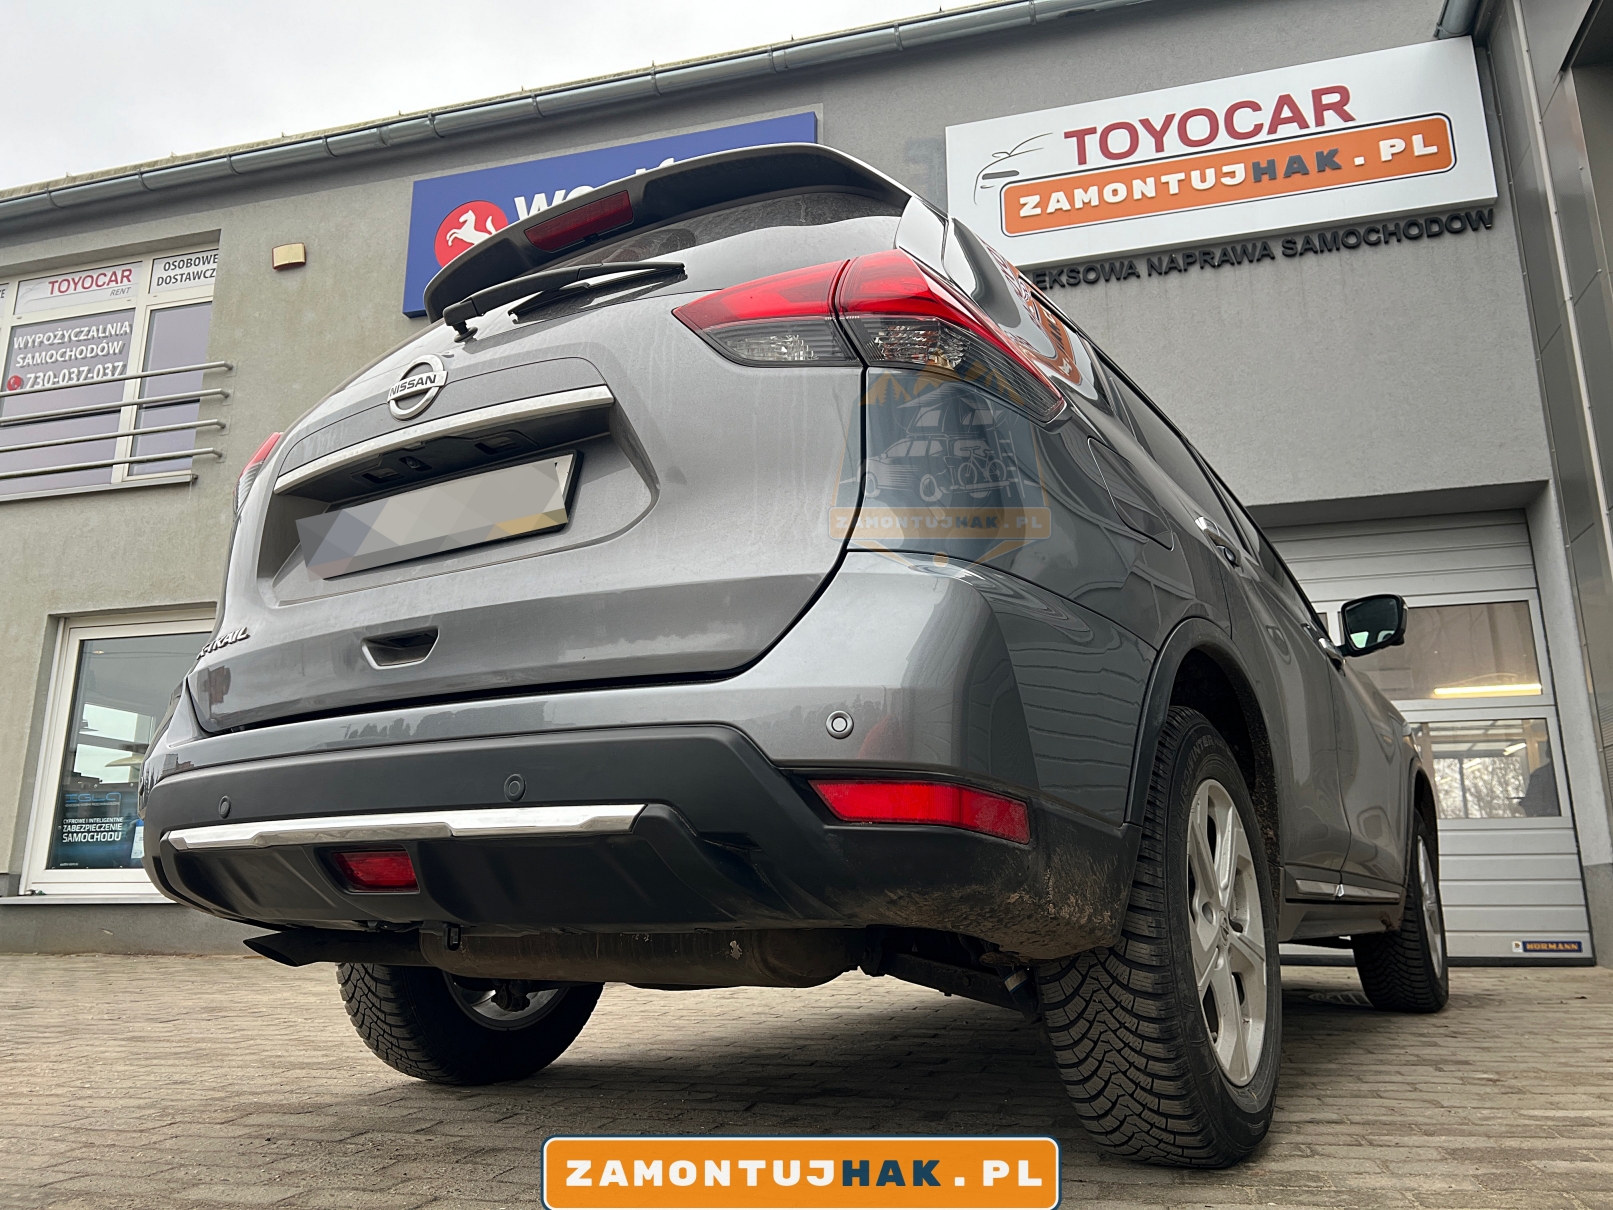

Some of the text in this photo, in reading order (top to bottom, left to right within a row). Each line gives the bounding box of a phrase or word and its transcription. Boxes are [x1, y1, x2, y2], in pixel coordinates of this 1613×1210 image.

[1064, 85, 1356, 165] TOYOCAR
[163, 253, 218, 271] OSOBOWE
[1147, 240, 1276, 278] NAPRAWA
[48, 268, 133, 295] TOYOCAR
[156, 267, 216, 286] DOSTAWCZ
[109, 287, 131, 297] RENT
[13, 321, 130, 349] WYPOŻYCZALNIA
[15, 340, 123, 367] SAMOCHODÓW
[25, 361, 124, 389] 730-037-037
[389, 374, 437, 397] NISSAN
[62, 832, 122, 843] SAMOCHODU
[63, 823, 122, 832] ZABEZPIECZENIE
